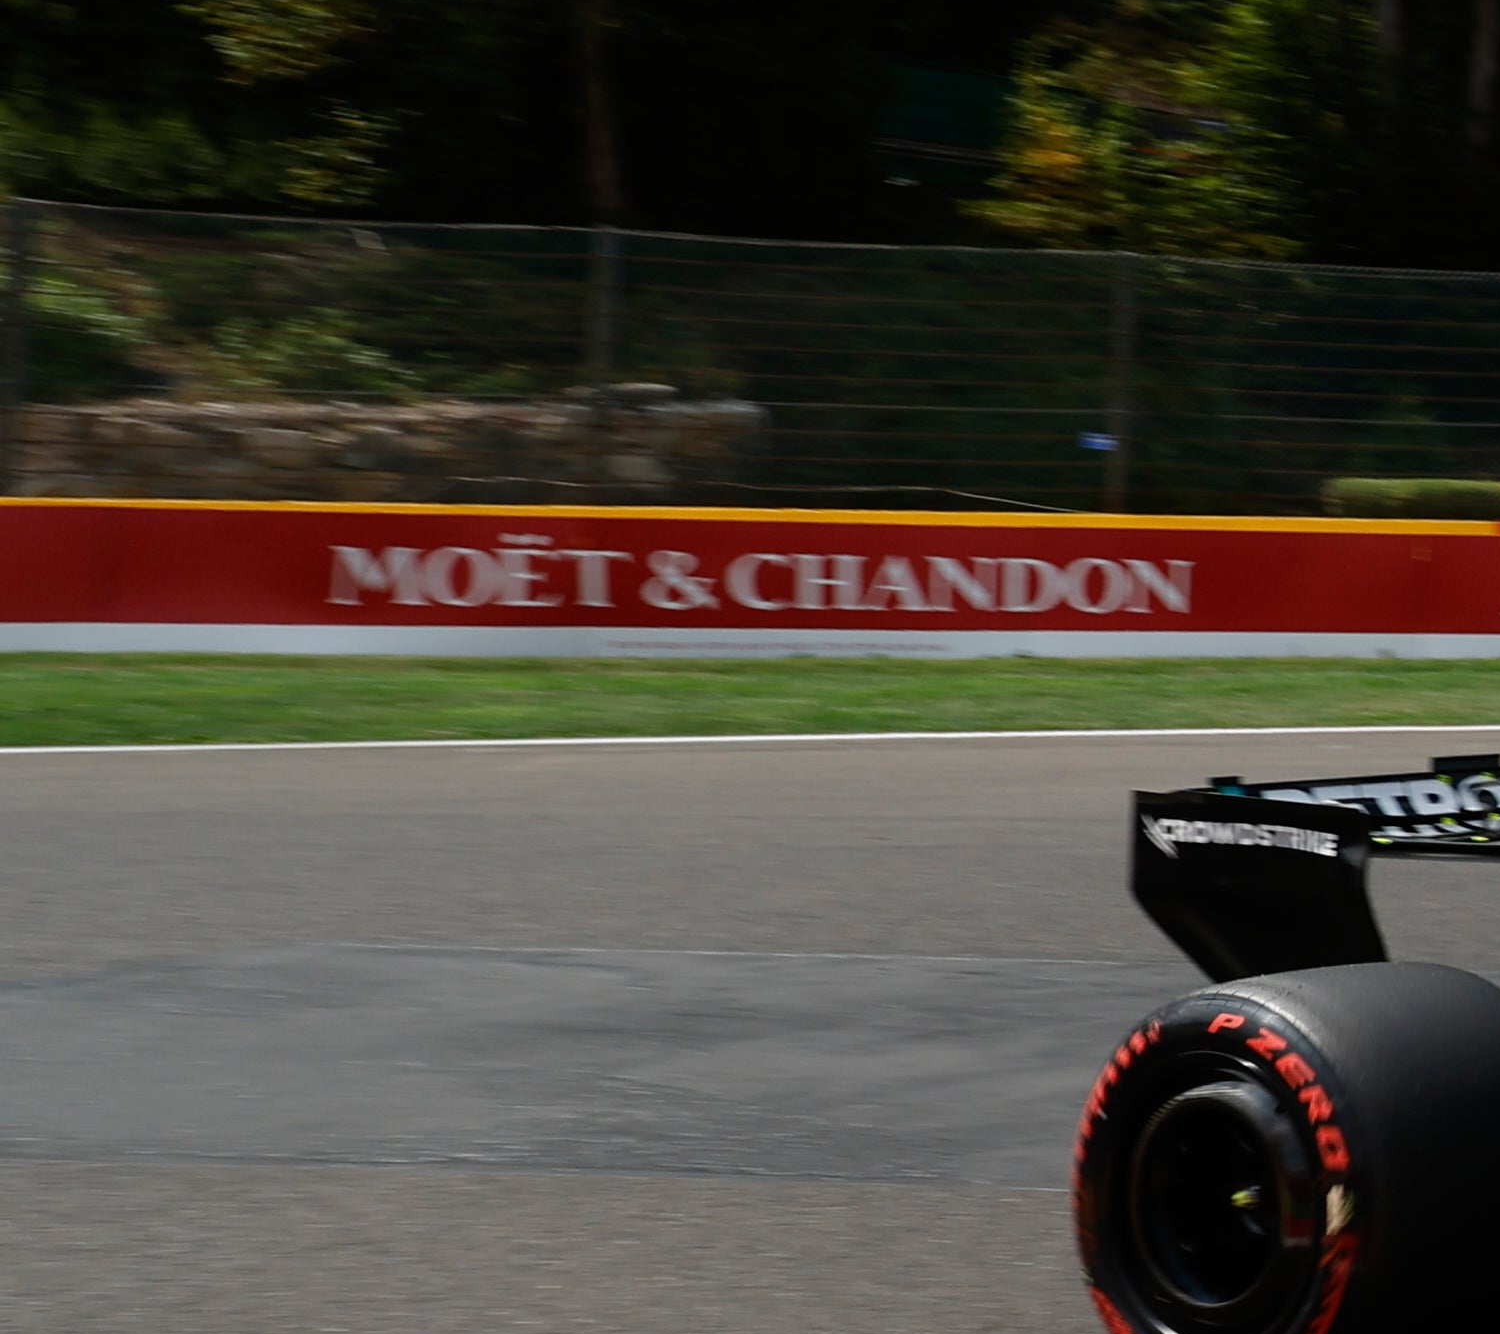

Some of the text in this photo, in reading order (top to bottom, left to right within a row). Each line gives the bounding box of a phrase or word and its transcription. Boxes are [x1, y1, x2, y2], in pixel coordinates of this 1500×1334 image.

[325, 533, 1194, 614] MOËT & CHANDON
[1207, 1012, 1246, 1034] P
[1246, 1027, 1352, 1172] ZERO
